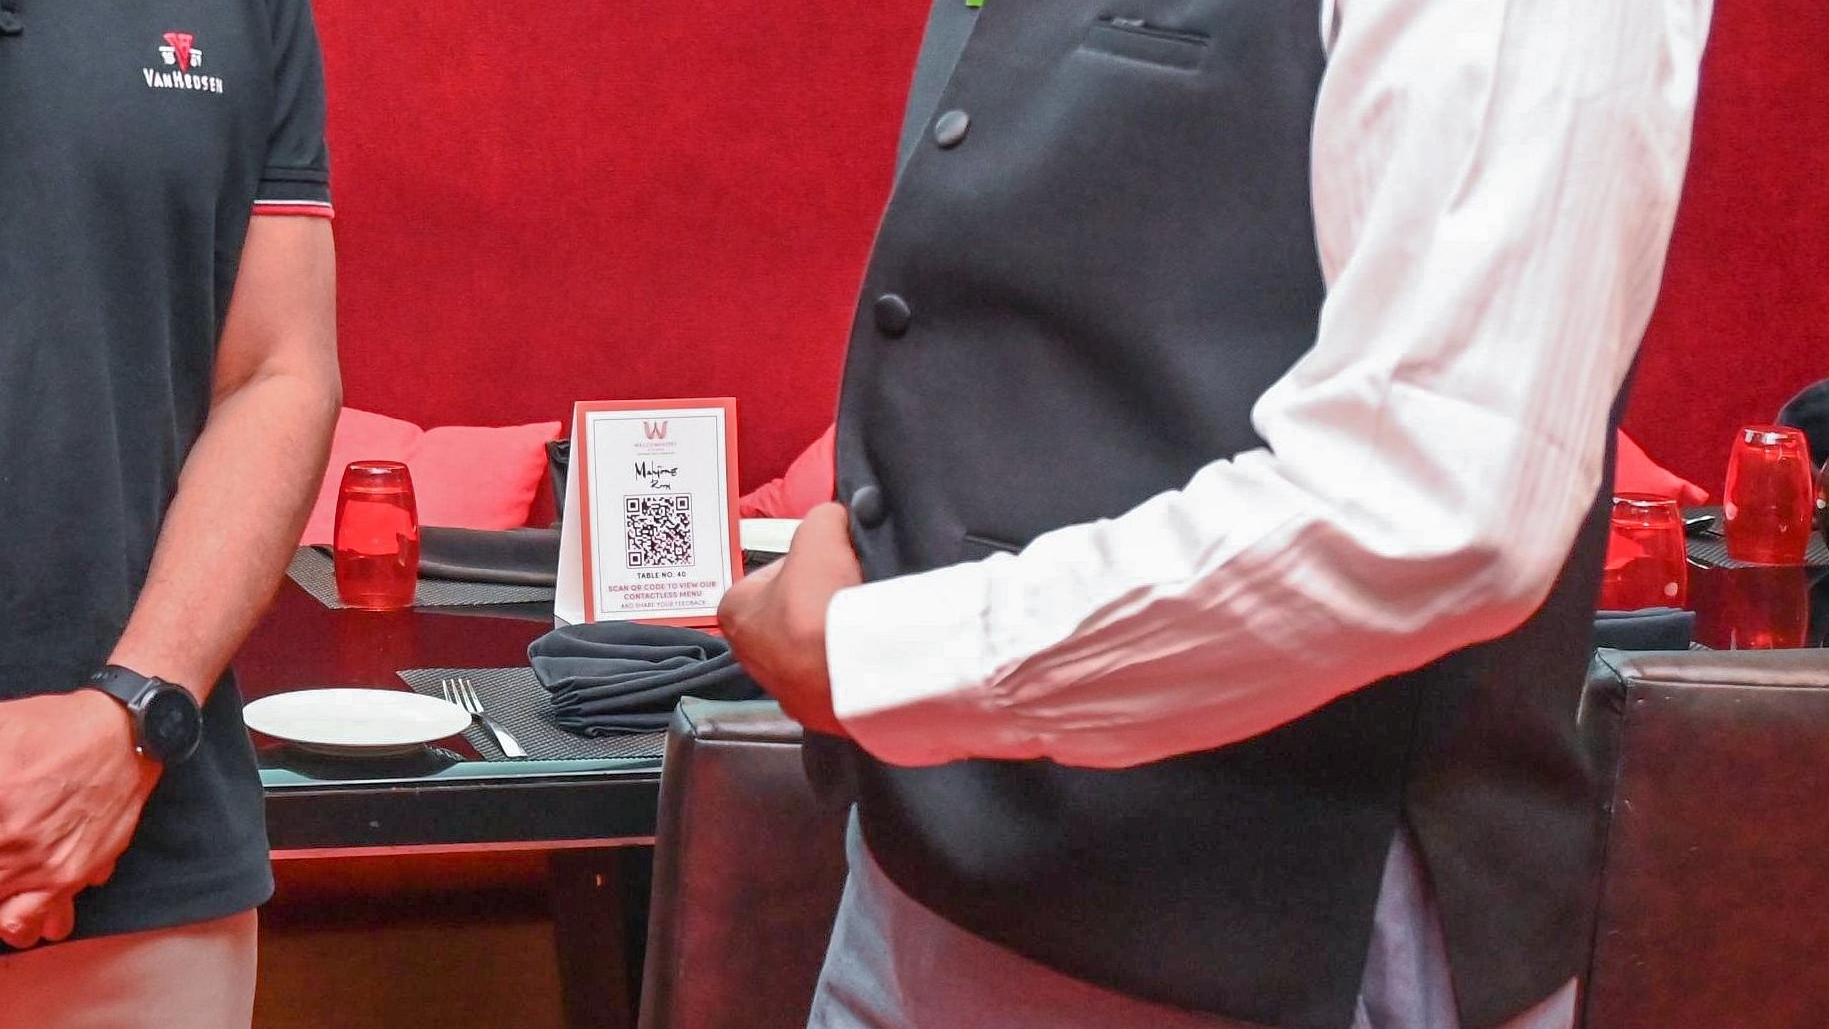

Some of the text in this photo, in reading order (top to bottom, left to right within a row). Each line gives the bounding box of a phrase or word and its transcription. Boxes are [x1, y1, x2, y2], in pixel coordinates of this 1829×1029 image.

[608, 585, 629, 593] SCAN
[631, 584, 642, 592] QR
[644, 583, 665, 591] CODE
[668, 582, 678, 590] TO
[680, 581, 698, 589] VIEW
[624, 592, 678, 600] CONTACTLESS
